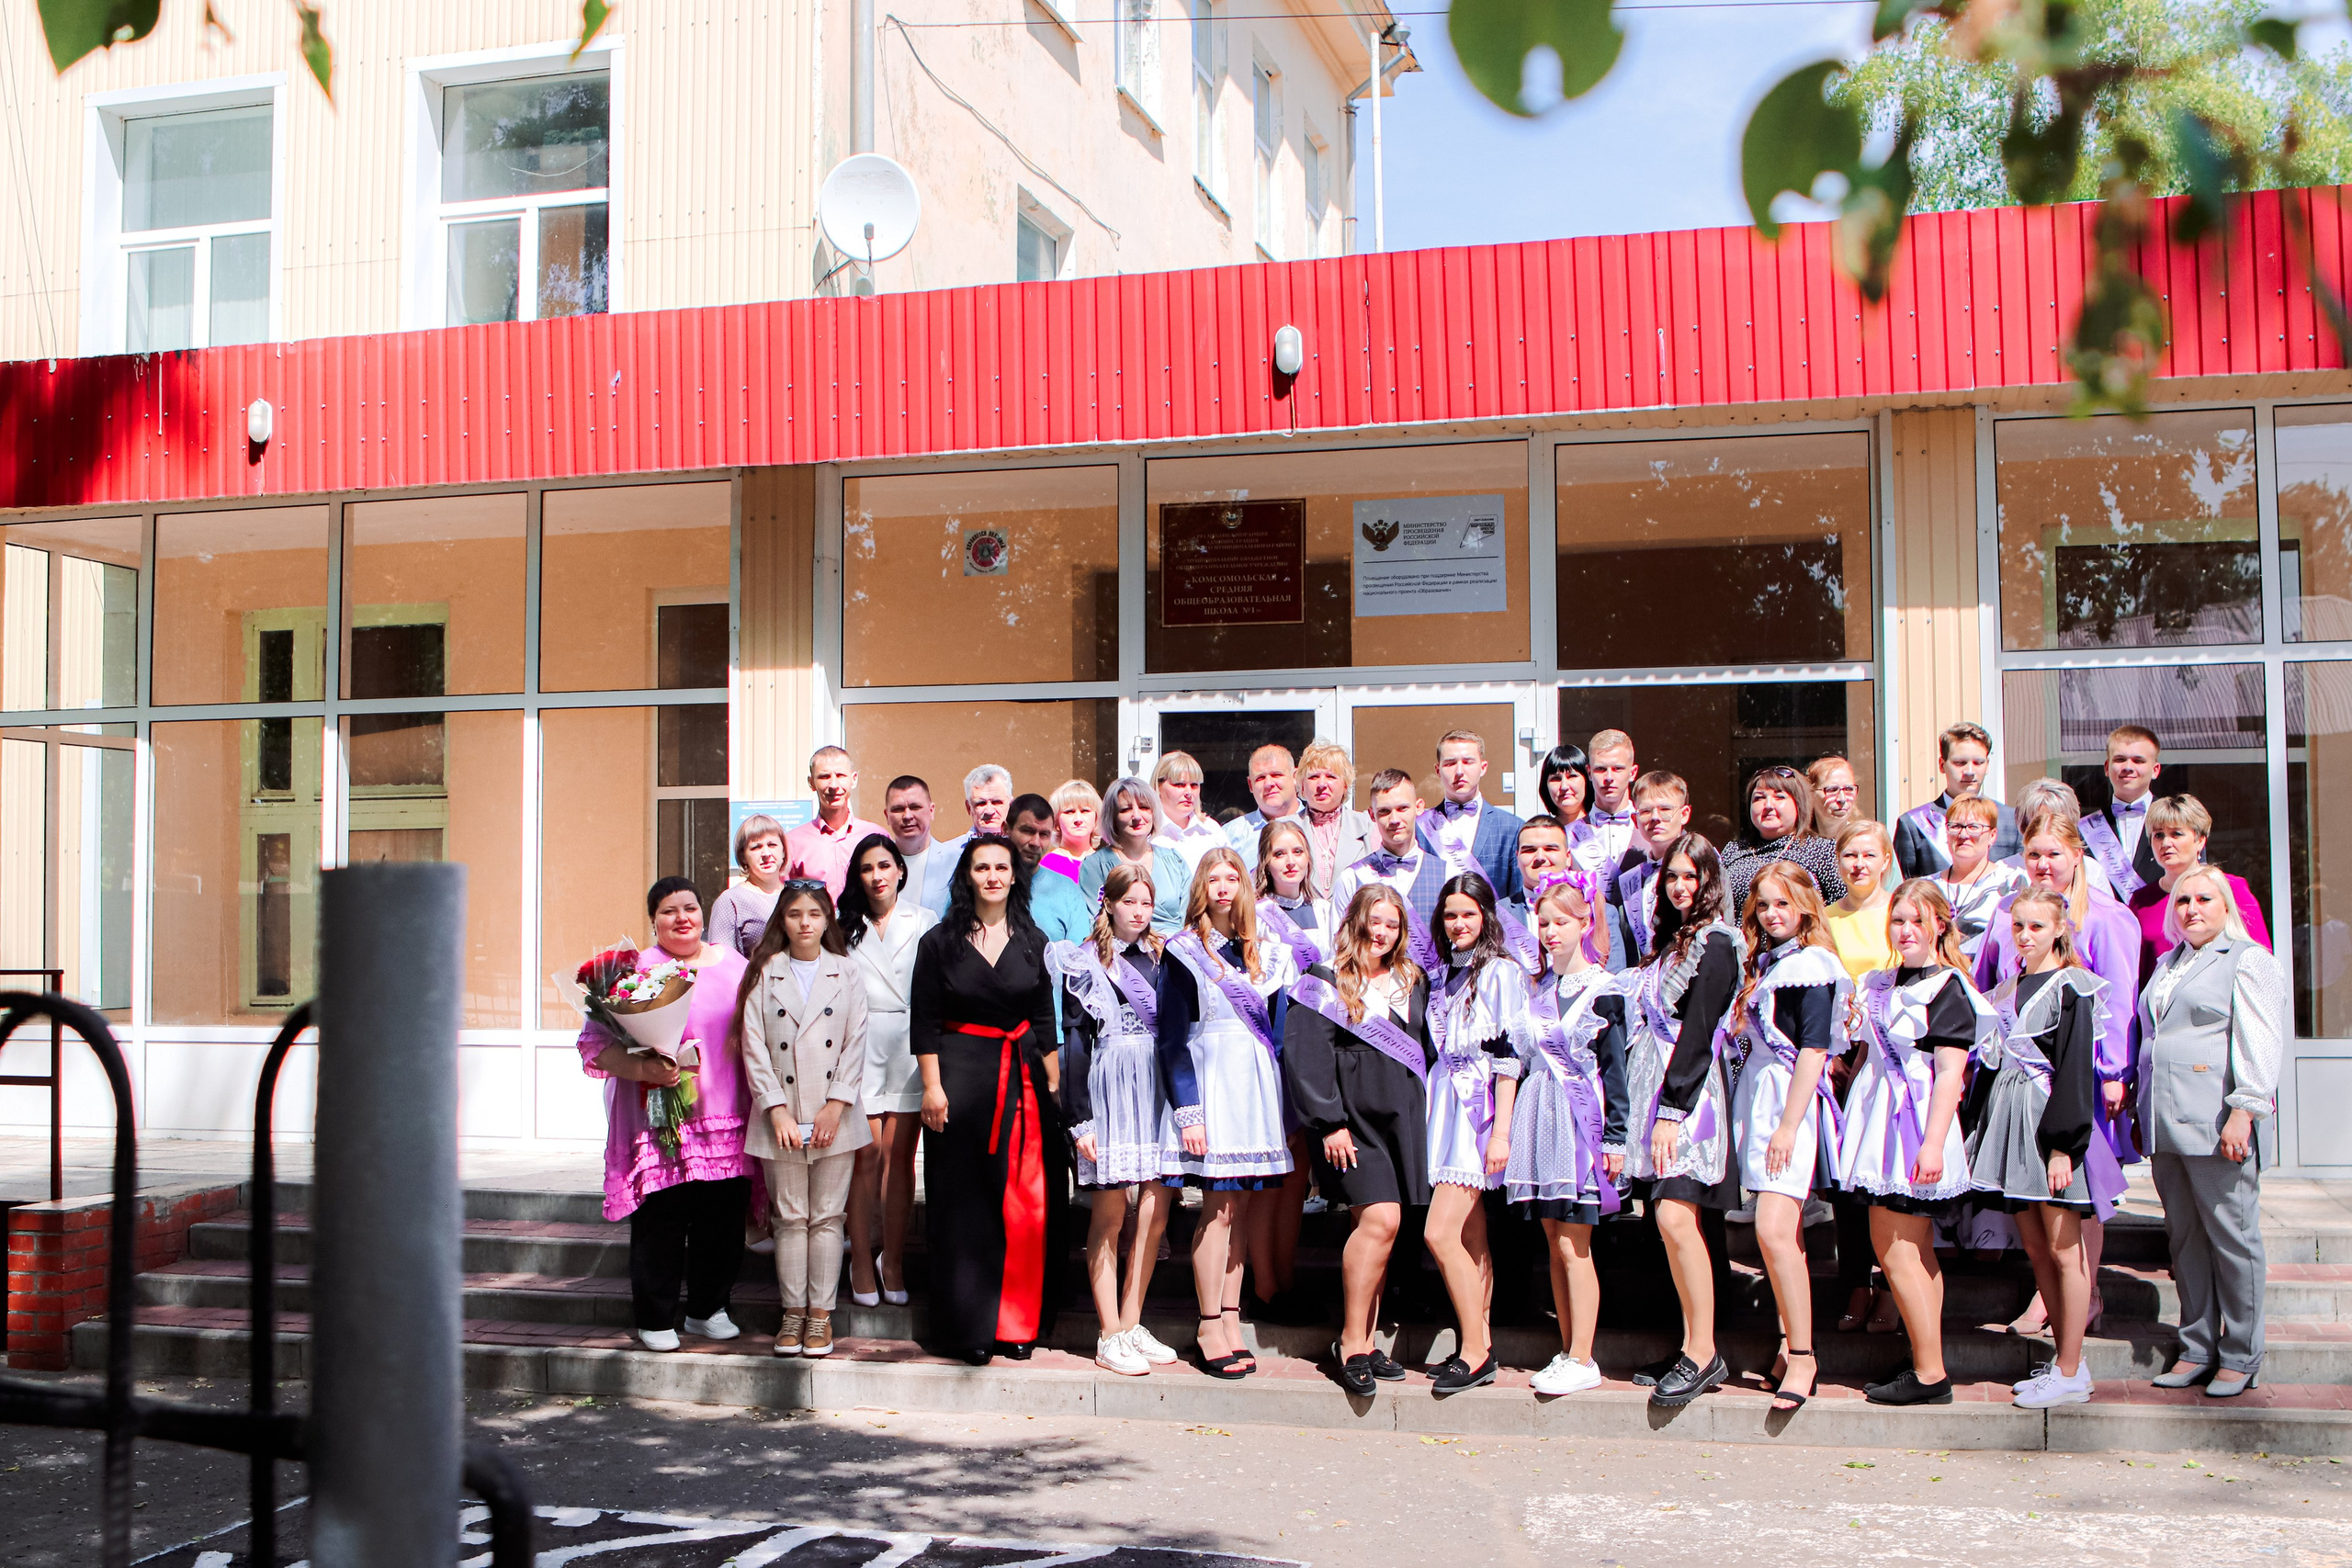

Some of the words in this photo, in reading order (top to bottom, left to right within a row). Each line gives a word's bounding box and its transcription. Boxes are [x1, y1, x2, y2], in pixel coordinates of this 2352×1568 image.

[1209, 585, 1253, 594] СРЕДНЯЯ
[1174, 595, 1291, 606] ОБЩЕОБРАЗОВАТЕЛЬНАЯ
[1204, 606, 1238, 615] ШКОЛА
